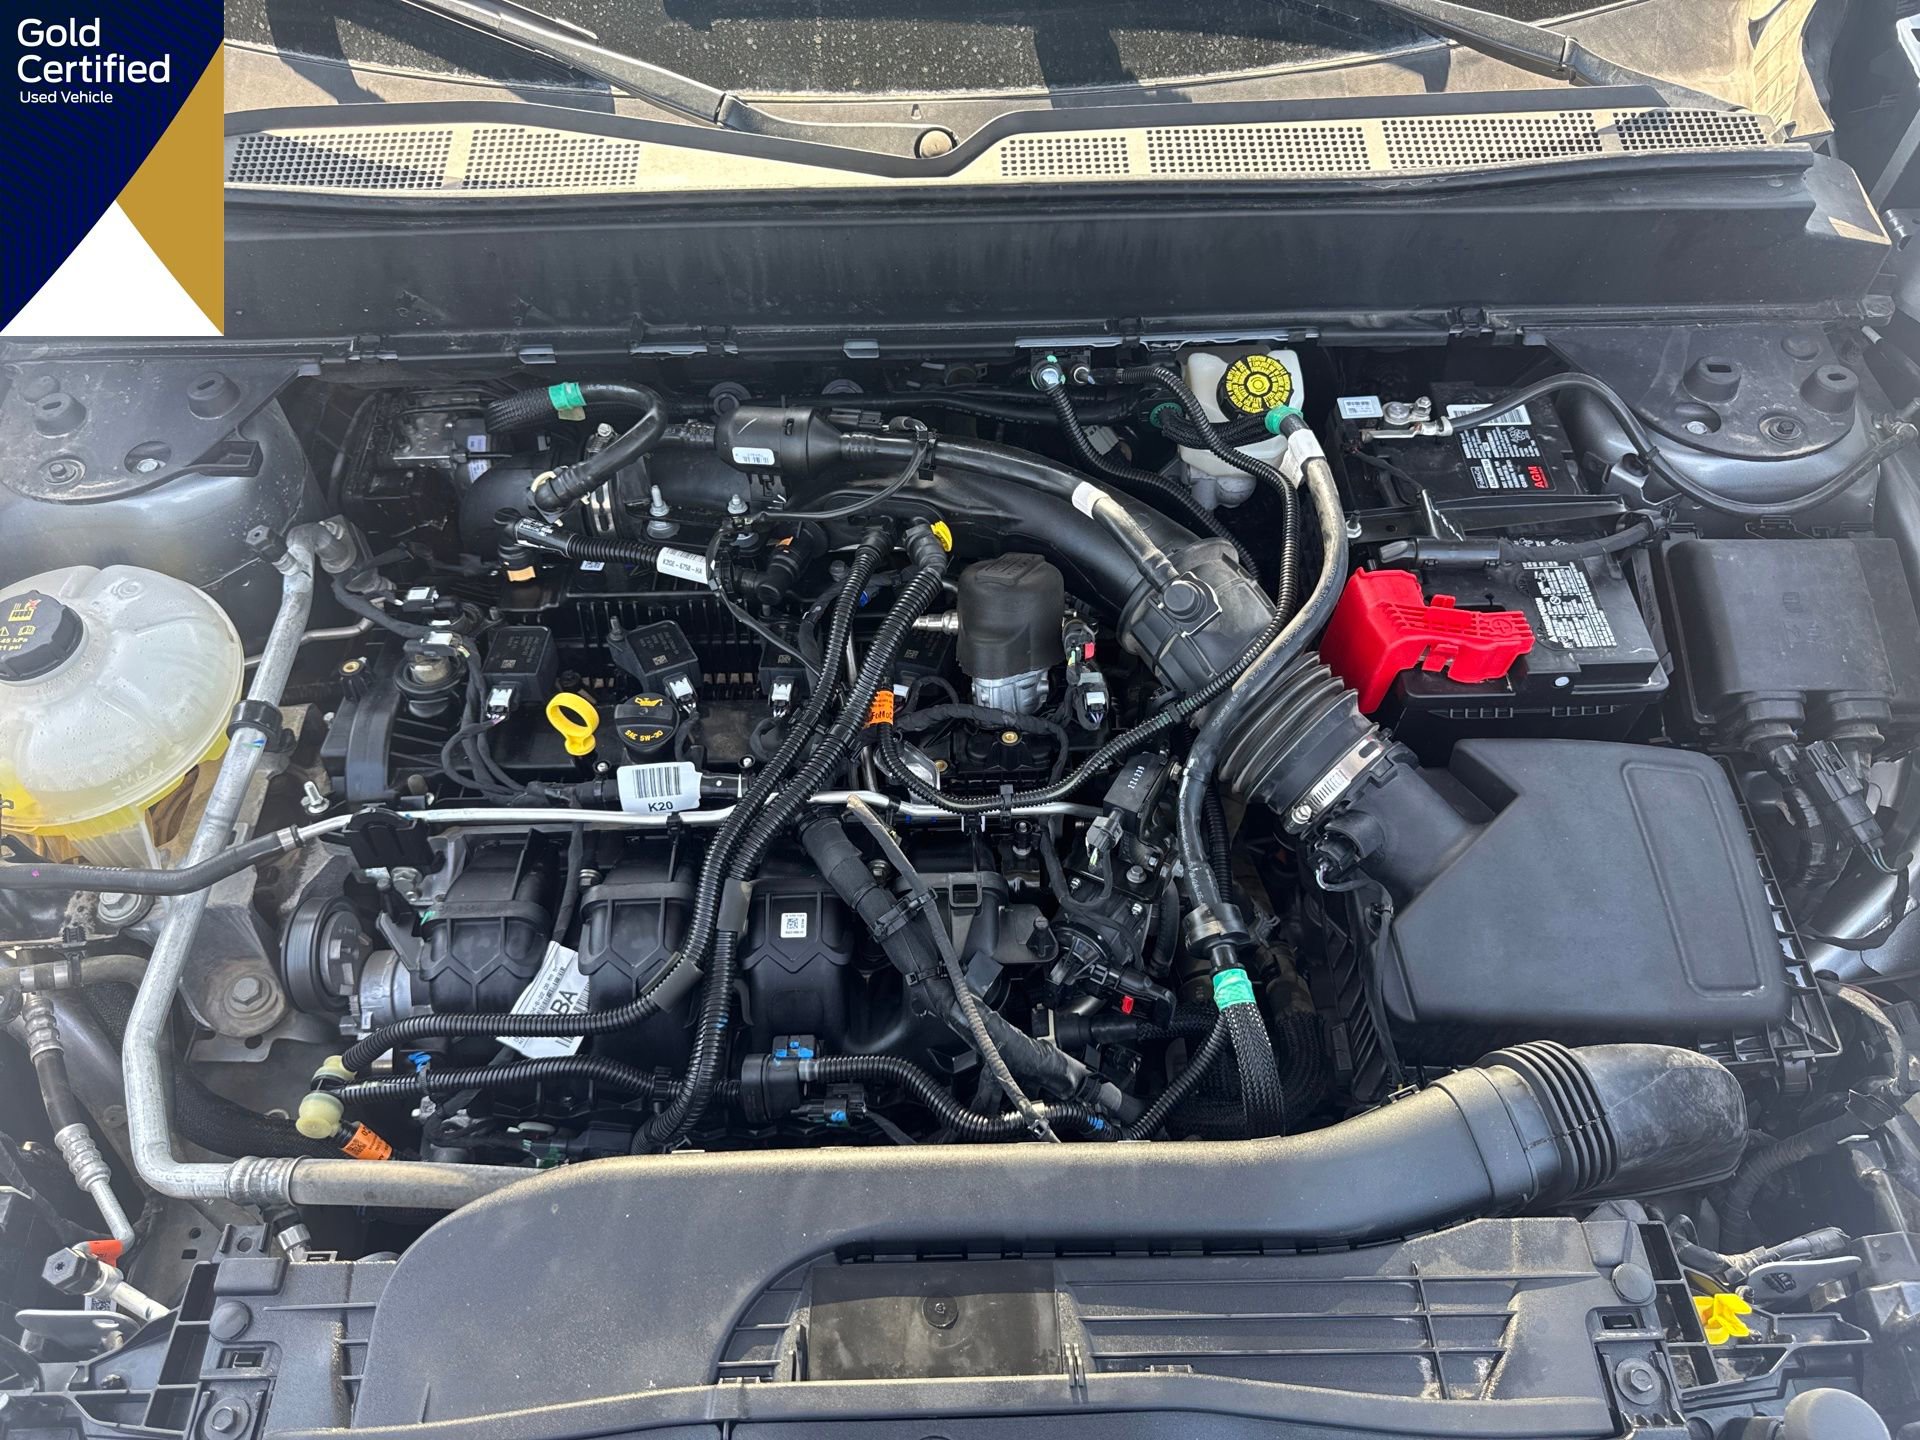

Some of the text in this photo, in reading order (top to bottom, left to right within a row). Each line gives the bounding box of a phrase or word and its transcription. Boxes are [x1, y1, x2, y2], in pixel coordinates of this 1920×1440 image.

[1528, 466, 1544, 489] AGM
[624, 729, 664, 742] SAE 5W-30
[648, 801, 674, 812] K20
